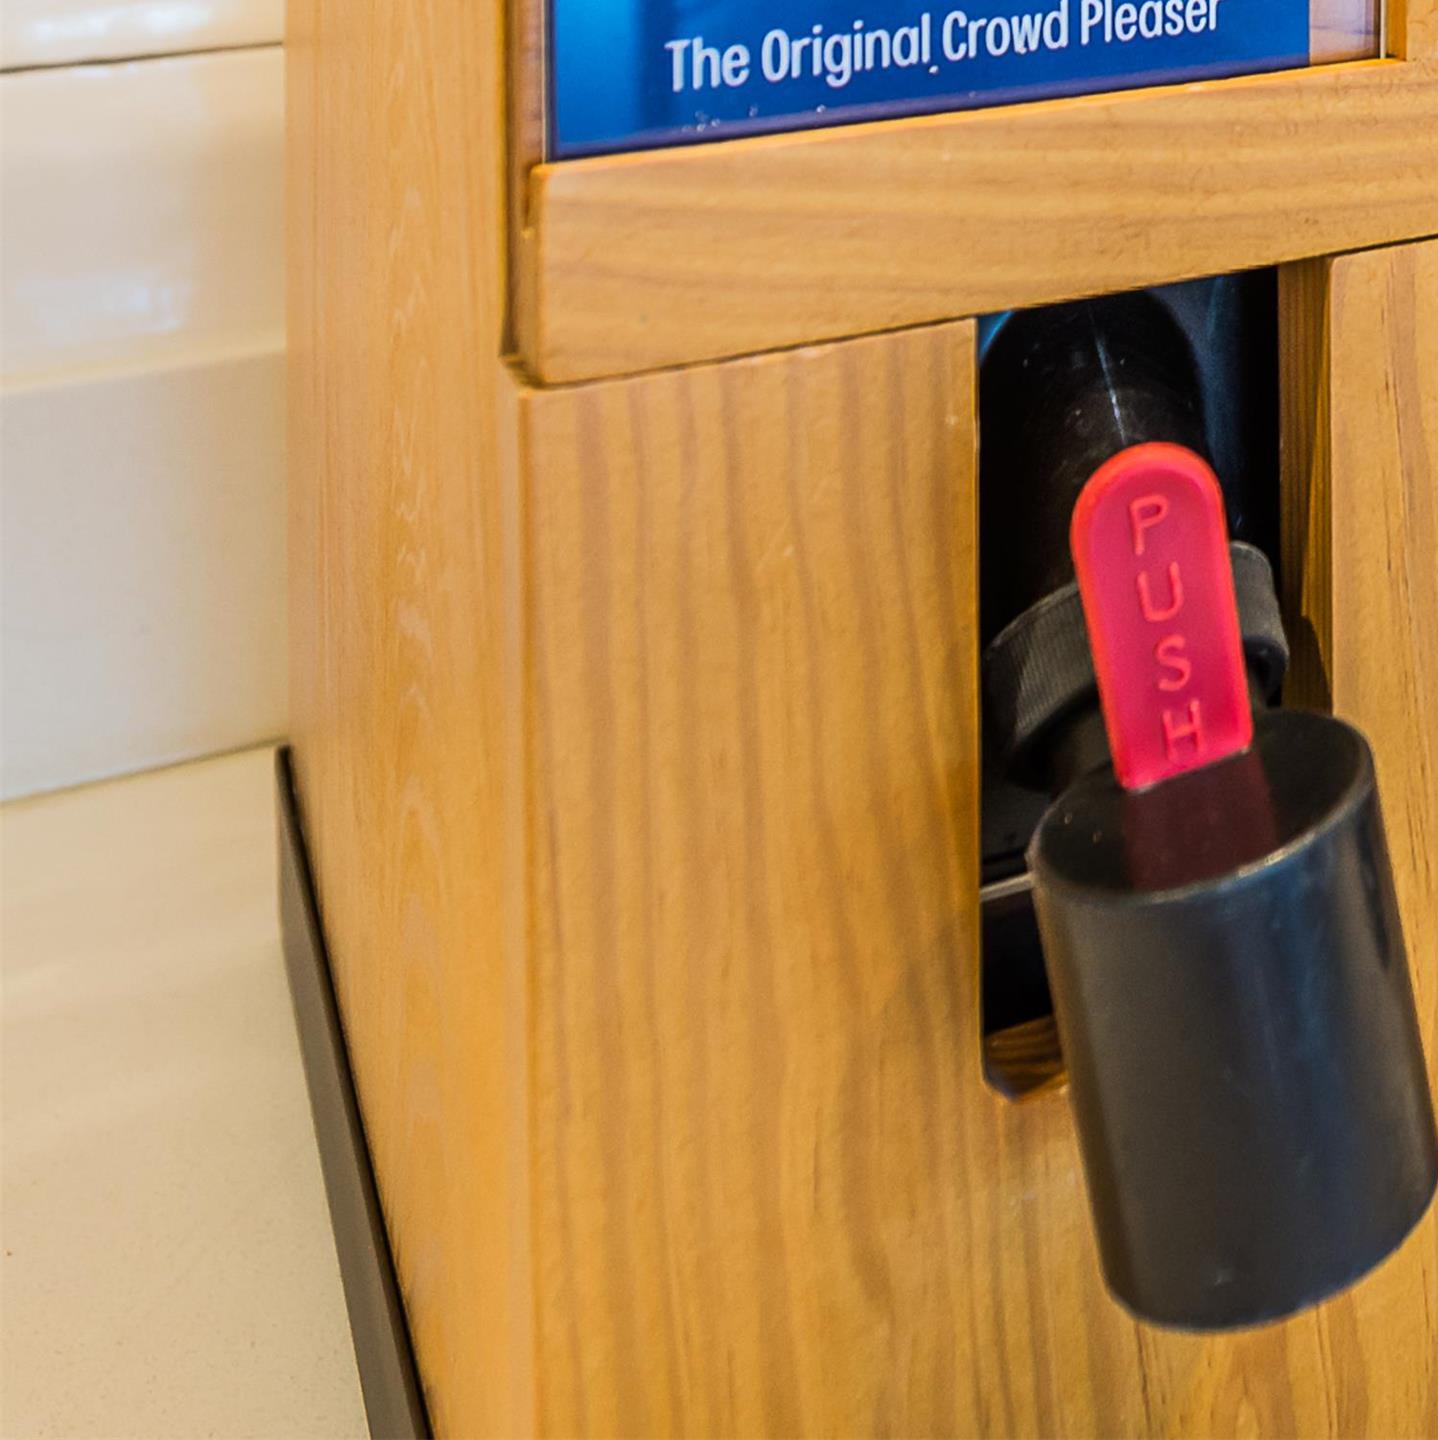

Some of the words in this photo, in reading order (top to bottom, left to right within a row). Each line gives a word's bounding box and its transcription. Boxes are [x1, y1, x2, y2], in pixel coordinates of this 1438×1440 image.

[665, 37, 750, 92] The
[762, 13, 931, 88] Original
[1129, 493, 1201, 761] PUSH
